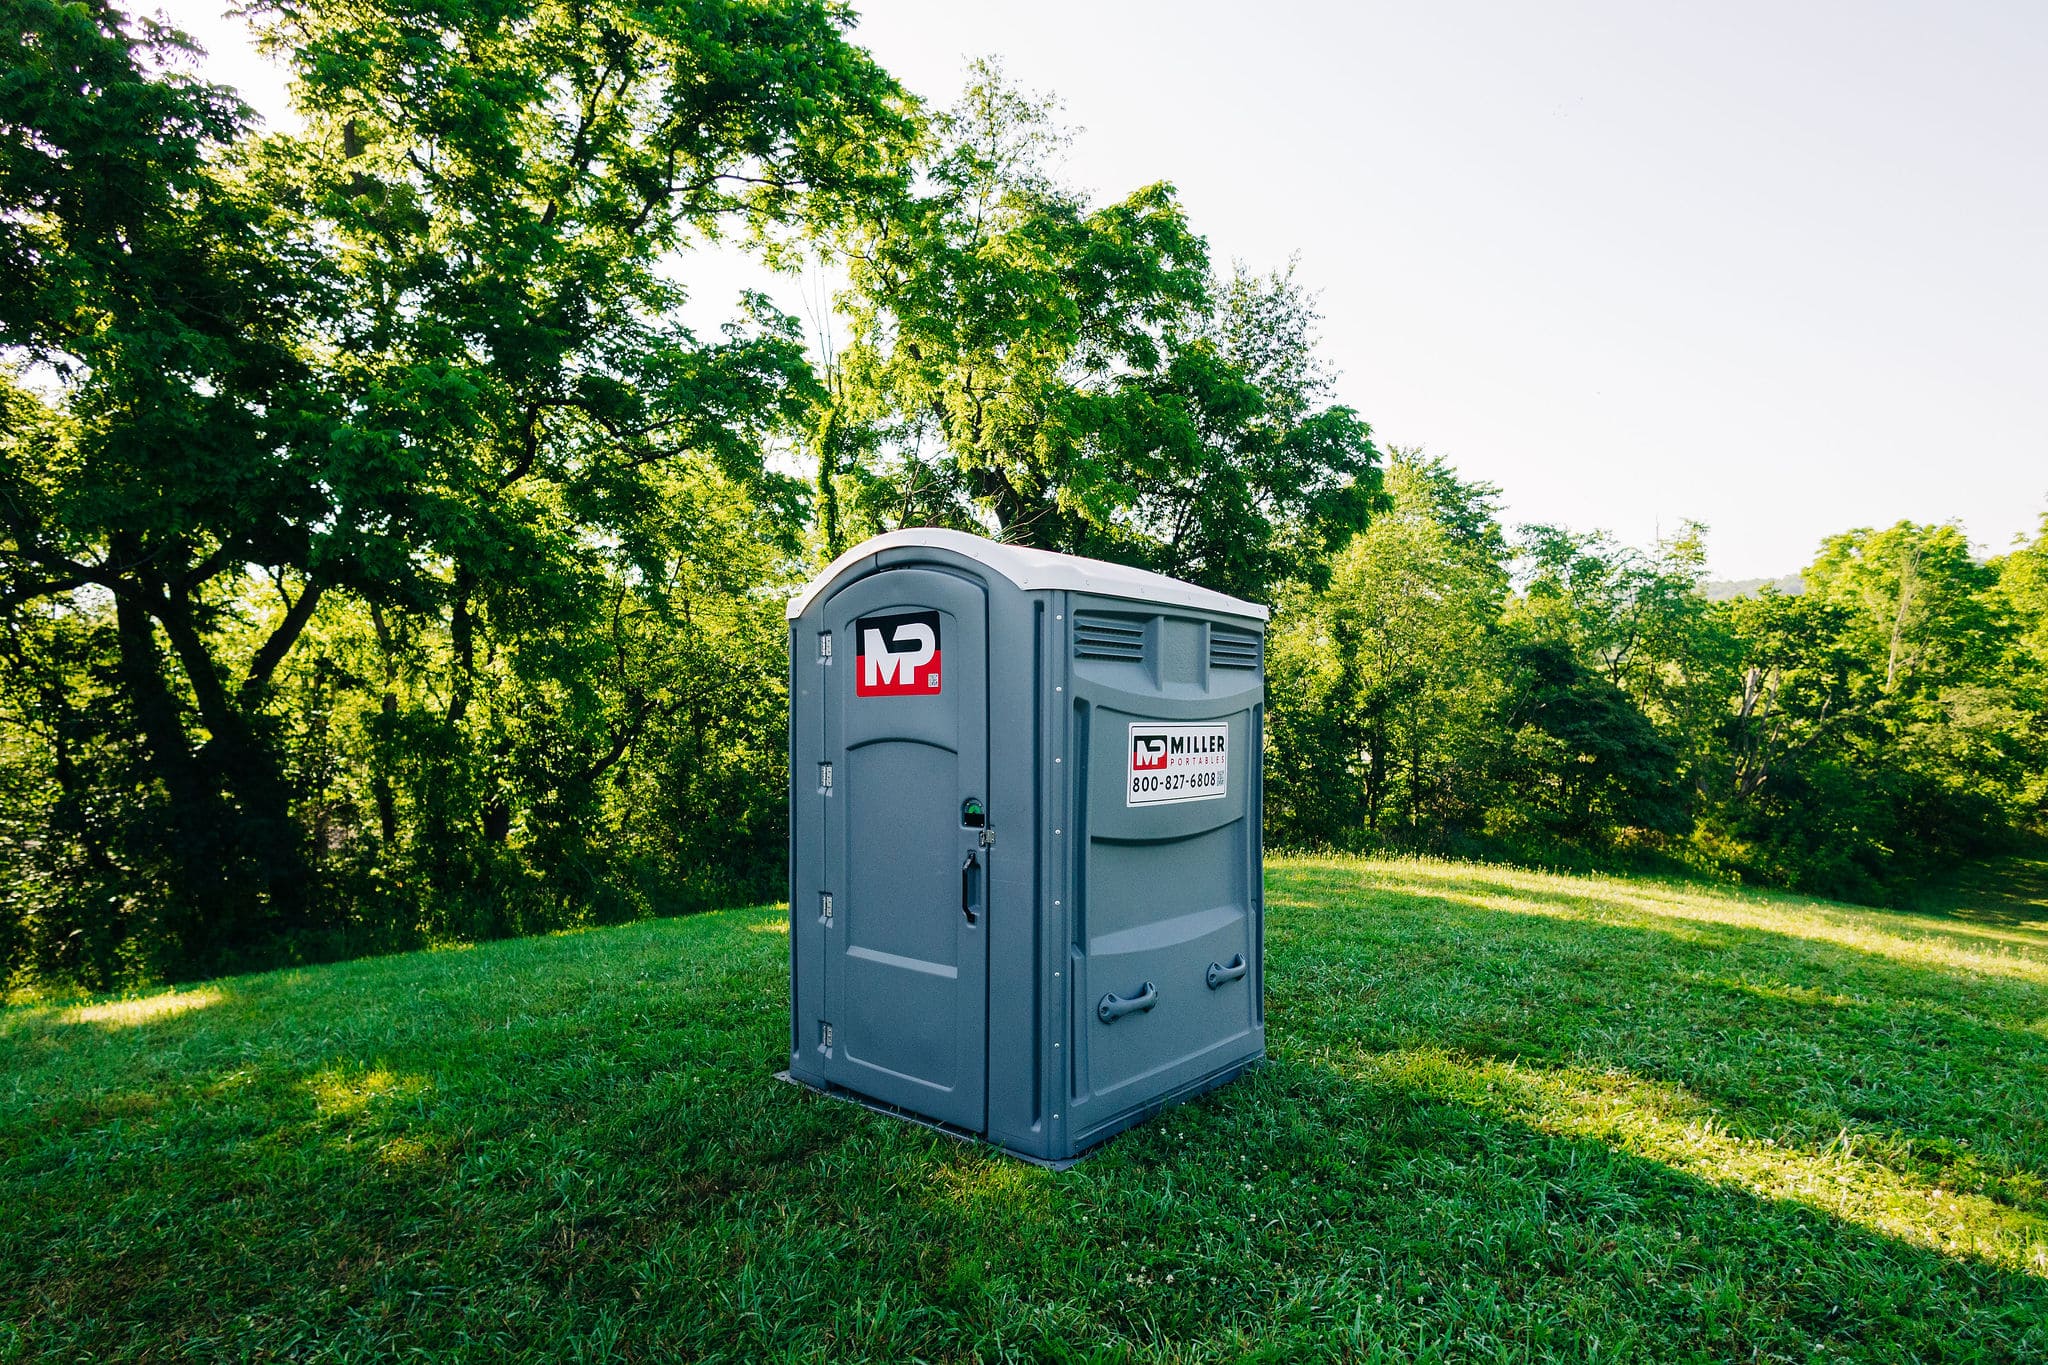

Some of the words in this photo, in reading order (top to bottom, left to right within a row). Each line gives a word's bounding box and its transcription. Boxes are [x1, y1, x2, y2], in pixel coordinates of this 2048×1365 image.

[863, 622, 936, 687] MP
[1136, 739, 1166, 766] MP
[1171, 736, 1225, 754] MILLER
[1170, 756, 1225, 766] PORTABLES
[1133, 772, 1216, 793] 800-827-6808
